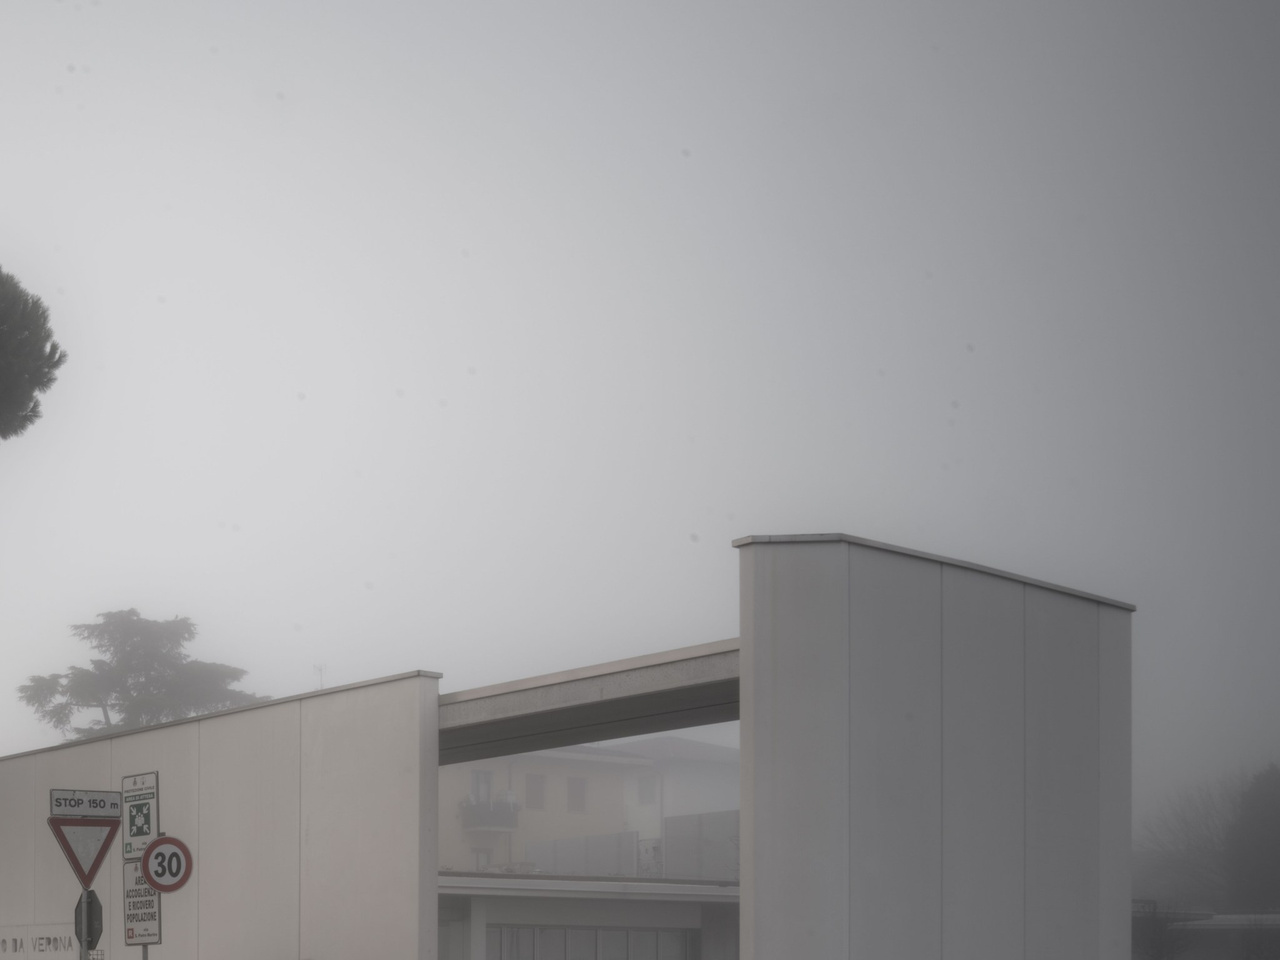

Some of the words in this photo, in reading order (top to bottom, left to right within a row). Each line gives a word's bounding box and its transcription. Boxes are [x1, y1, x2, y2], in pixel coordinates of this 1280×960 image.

[55, 798, 84, 808] STOP
[88, 799, 106, 809] 150
[154, 851, 181, 878] 30
[126, 887, 156, 899] ACCOGLIENZA
[128, 901, 132, 911] E
[132, 899, 154, 910] RICOVERO
[126, 912, 157, 923] POPOLAZIONE
[31, 936, 74, 952] VERONA
